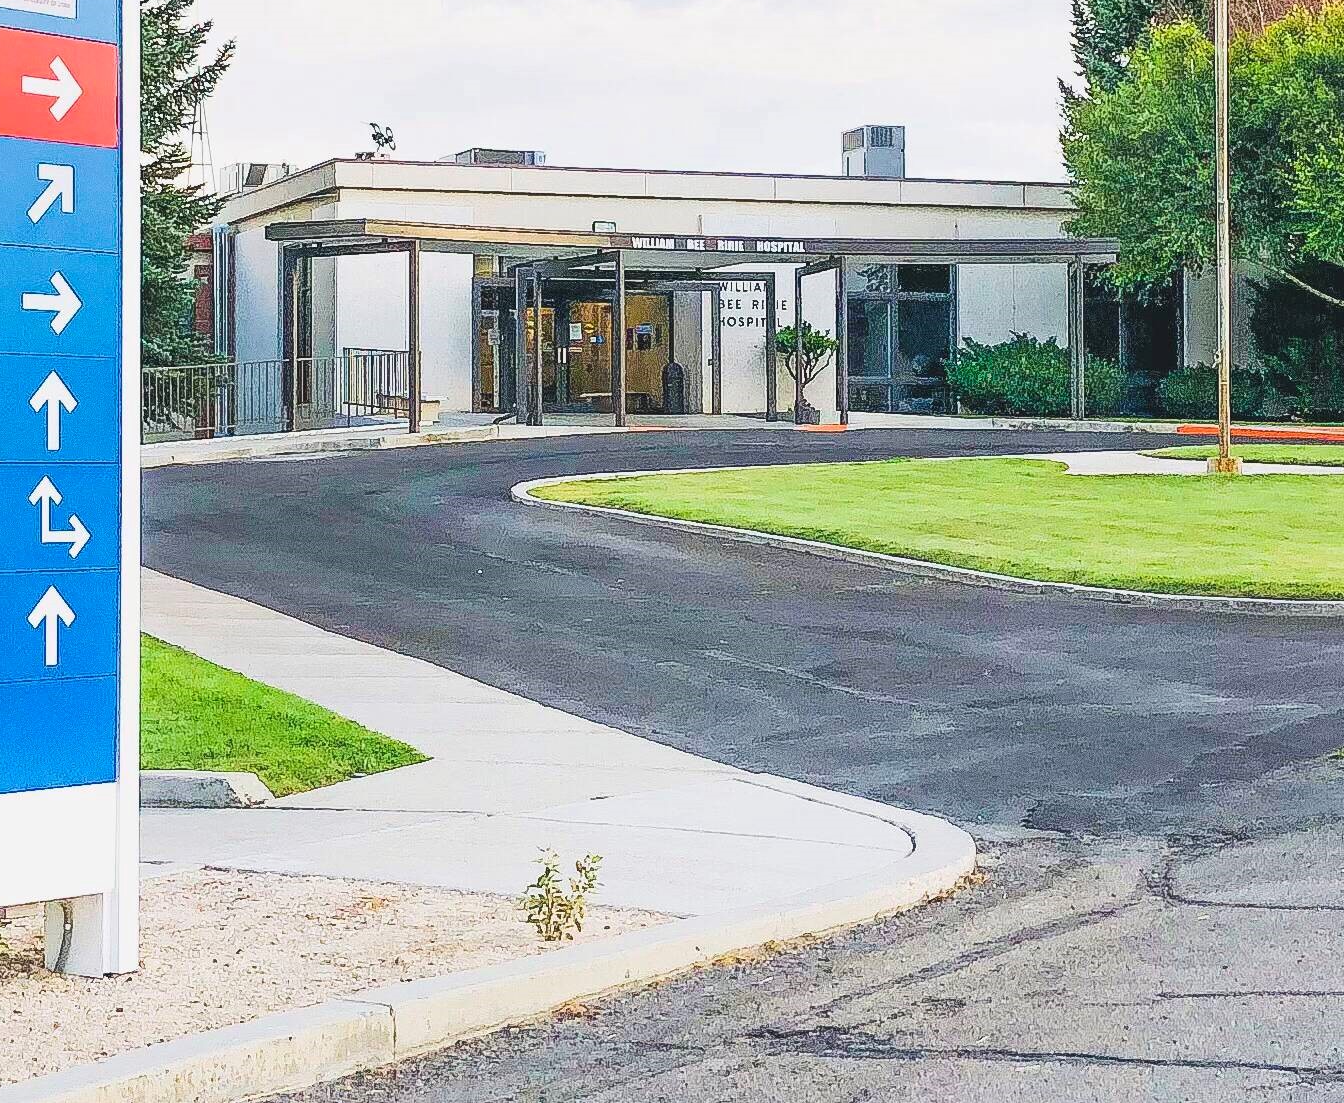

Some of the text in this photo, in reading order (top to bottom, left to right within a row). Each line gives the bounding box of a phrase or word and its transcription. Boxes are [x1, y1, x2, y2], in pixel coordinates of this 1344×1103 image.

[631, 236, 805, 253] WILLIAM BEE RIRIE HOSPITAL
[752, 300, 787, 310] RIIE
[720, 317, 782, 327] HOSPITL
